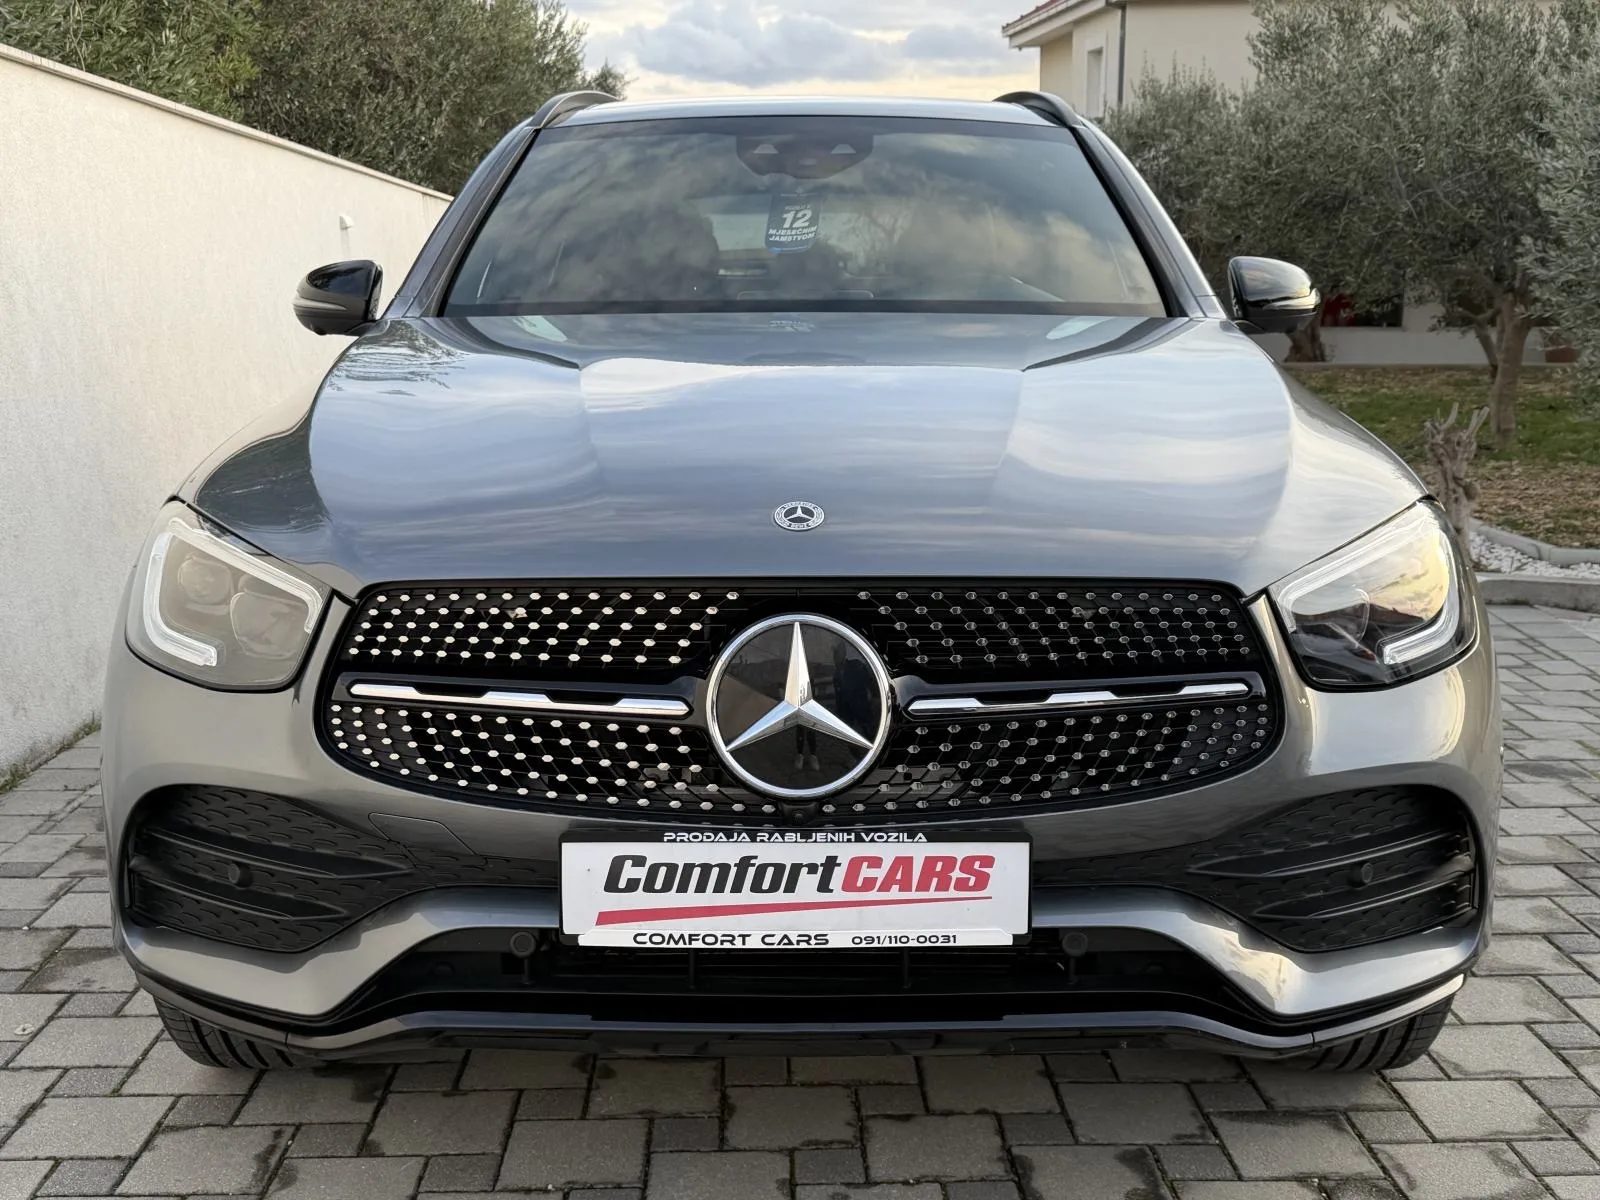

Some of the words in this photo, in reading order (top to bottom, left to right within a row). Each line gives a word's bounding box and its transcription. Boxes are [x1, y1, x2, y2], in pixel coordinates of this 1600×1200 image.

[782, 209, 812, 228] 12
[769, 233, 815, 241] JAMSTVOM
[663, 832, 751, 843] PRODAJA
[756, 832, 855, 843] RABLJENIH
[860, 832, 928, 843] VOZILA
[603, 854, 996, 894] ComfortCARS
[633, 932, 751, 946] COMFORT
[761, 933, 830, 946] CARS
[851, 934, 957, 946] 091/110-0031
